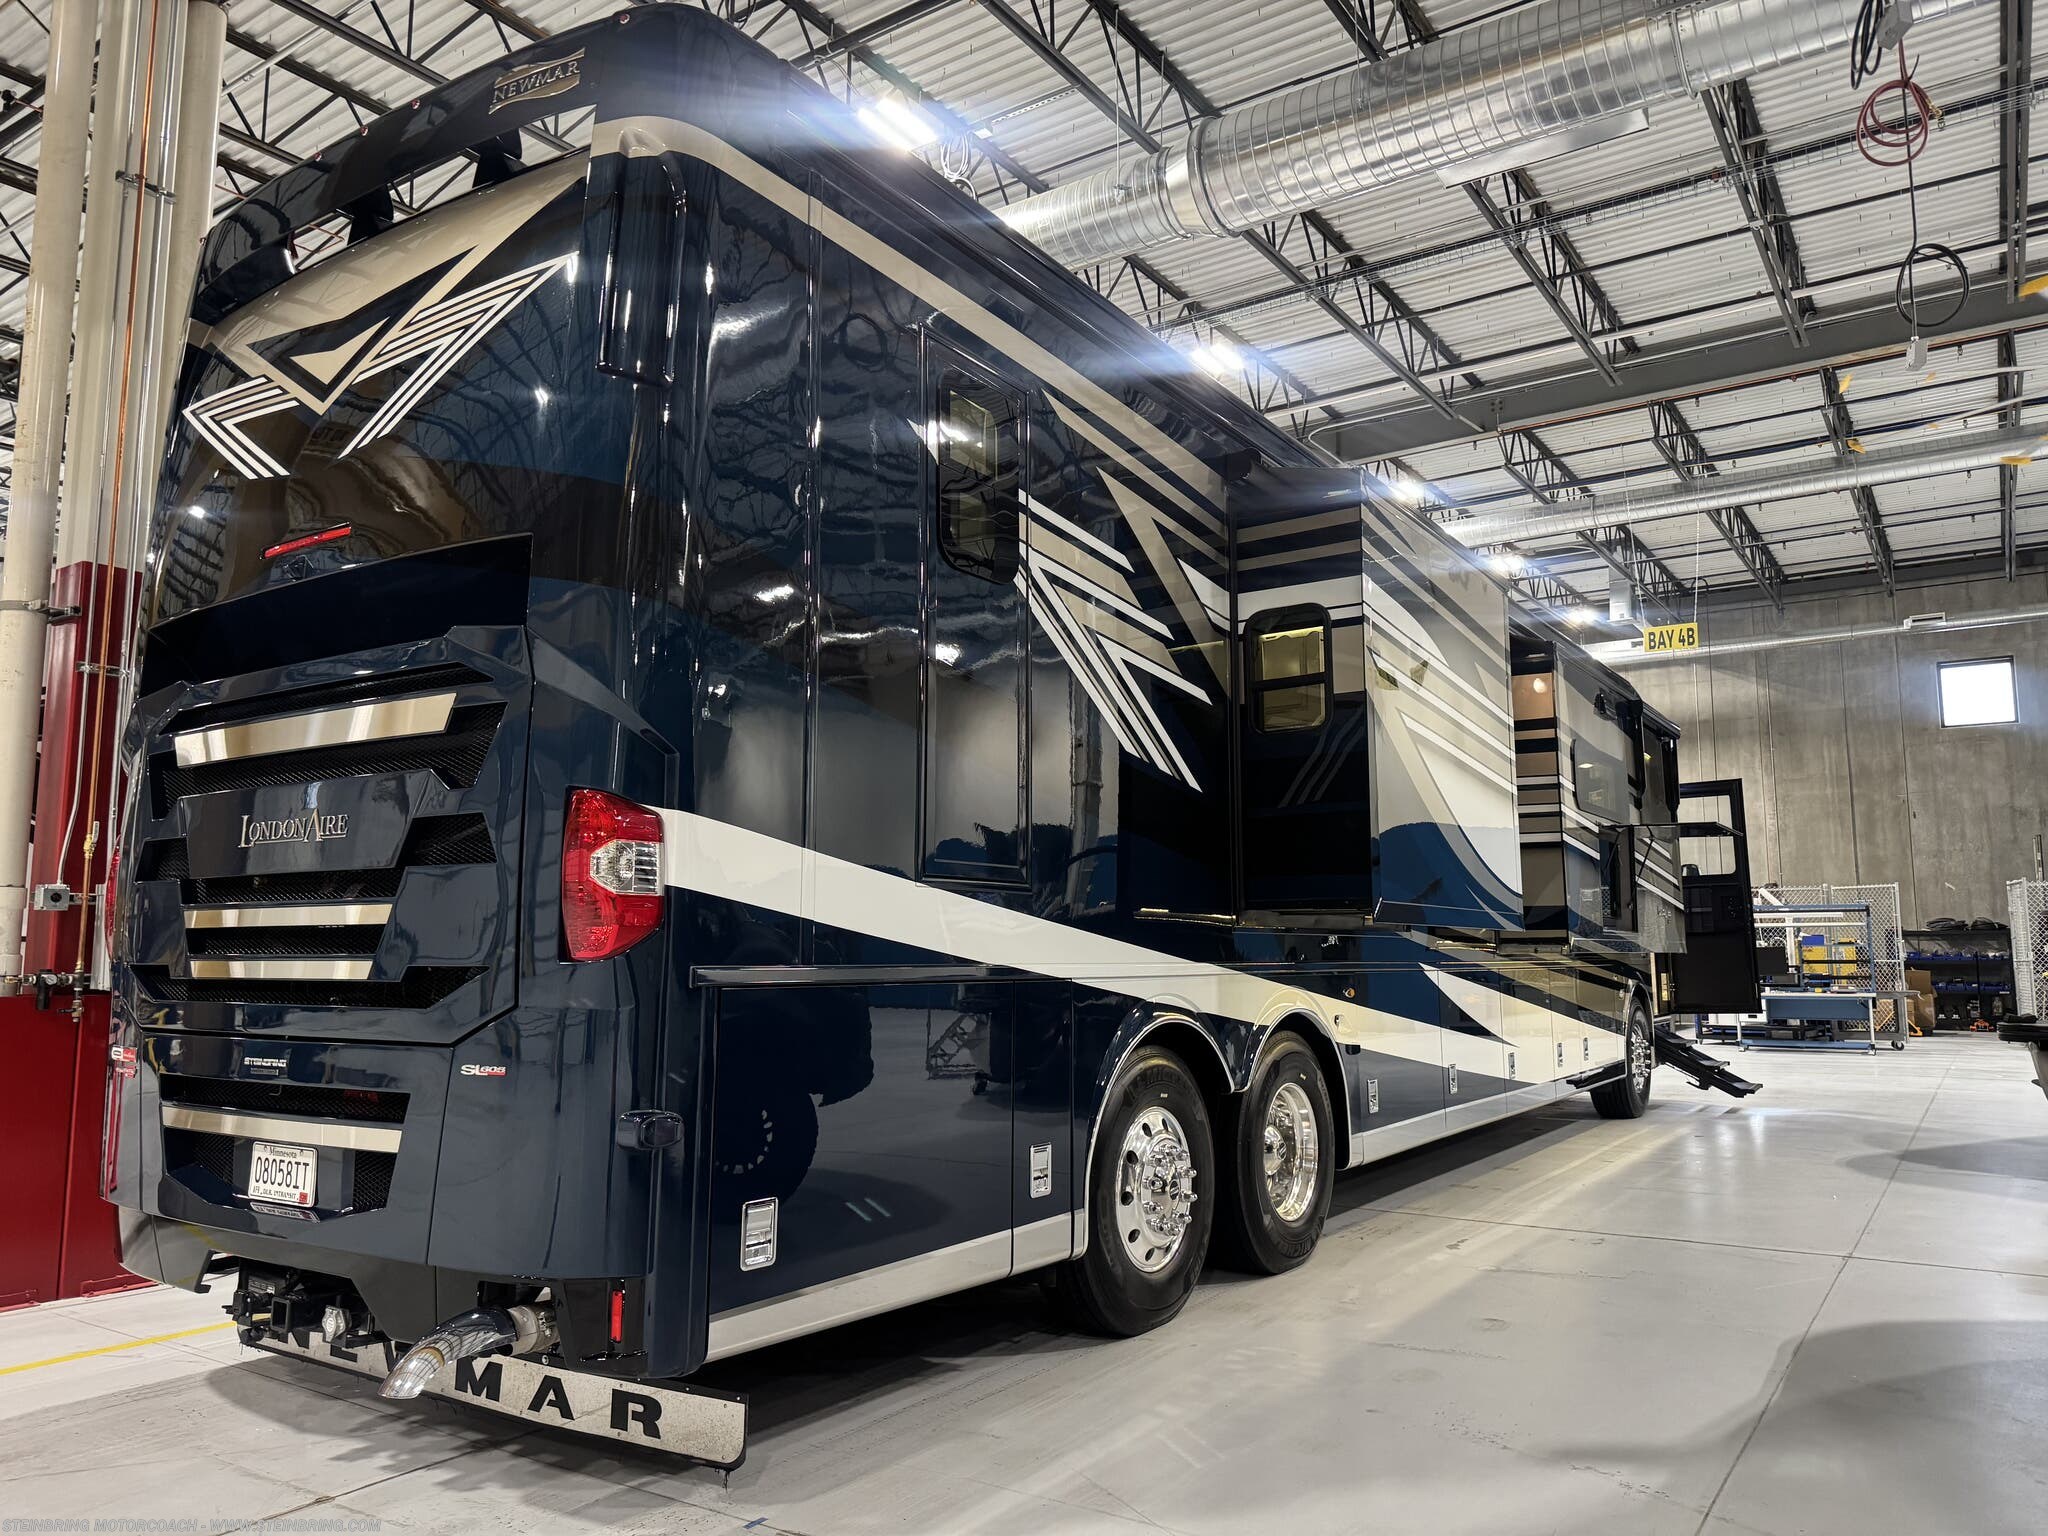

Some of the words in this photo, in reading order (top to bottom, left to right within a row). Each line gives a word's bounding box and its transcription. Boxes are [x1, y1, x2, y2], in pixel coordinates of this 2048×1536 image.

[492, 61, 581, 103] NEWMAR
[1648, 629, 1674, 650] BAY
[1678, 627, 1696, 647] 4B
[269, 1146, 297, 1158] Minnesota
[255, 1157, 309, 1190] 08058IT
